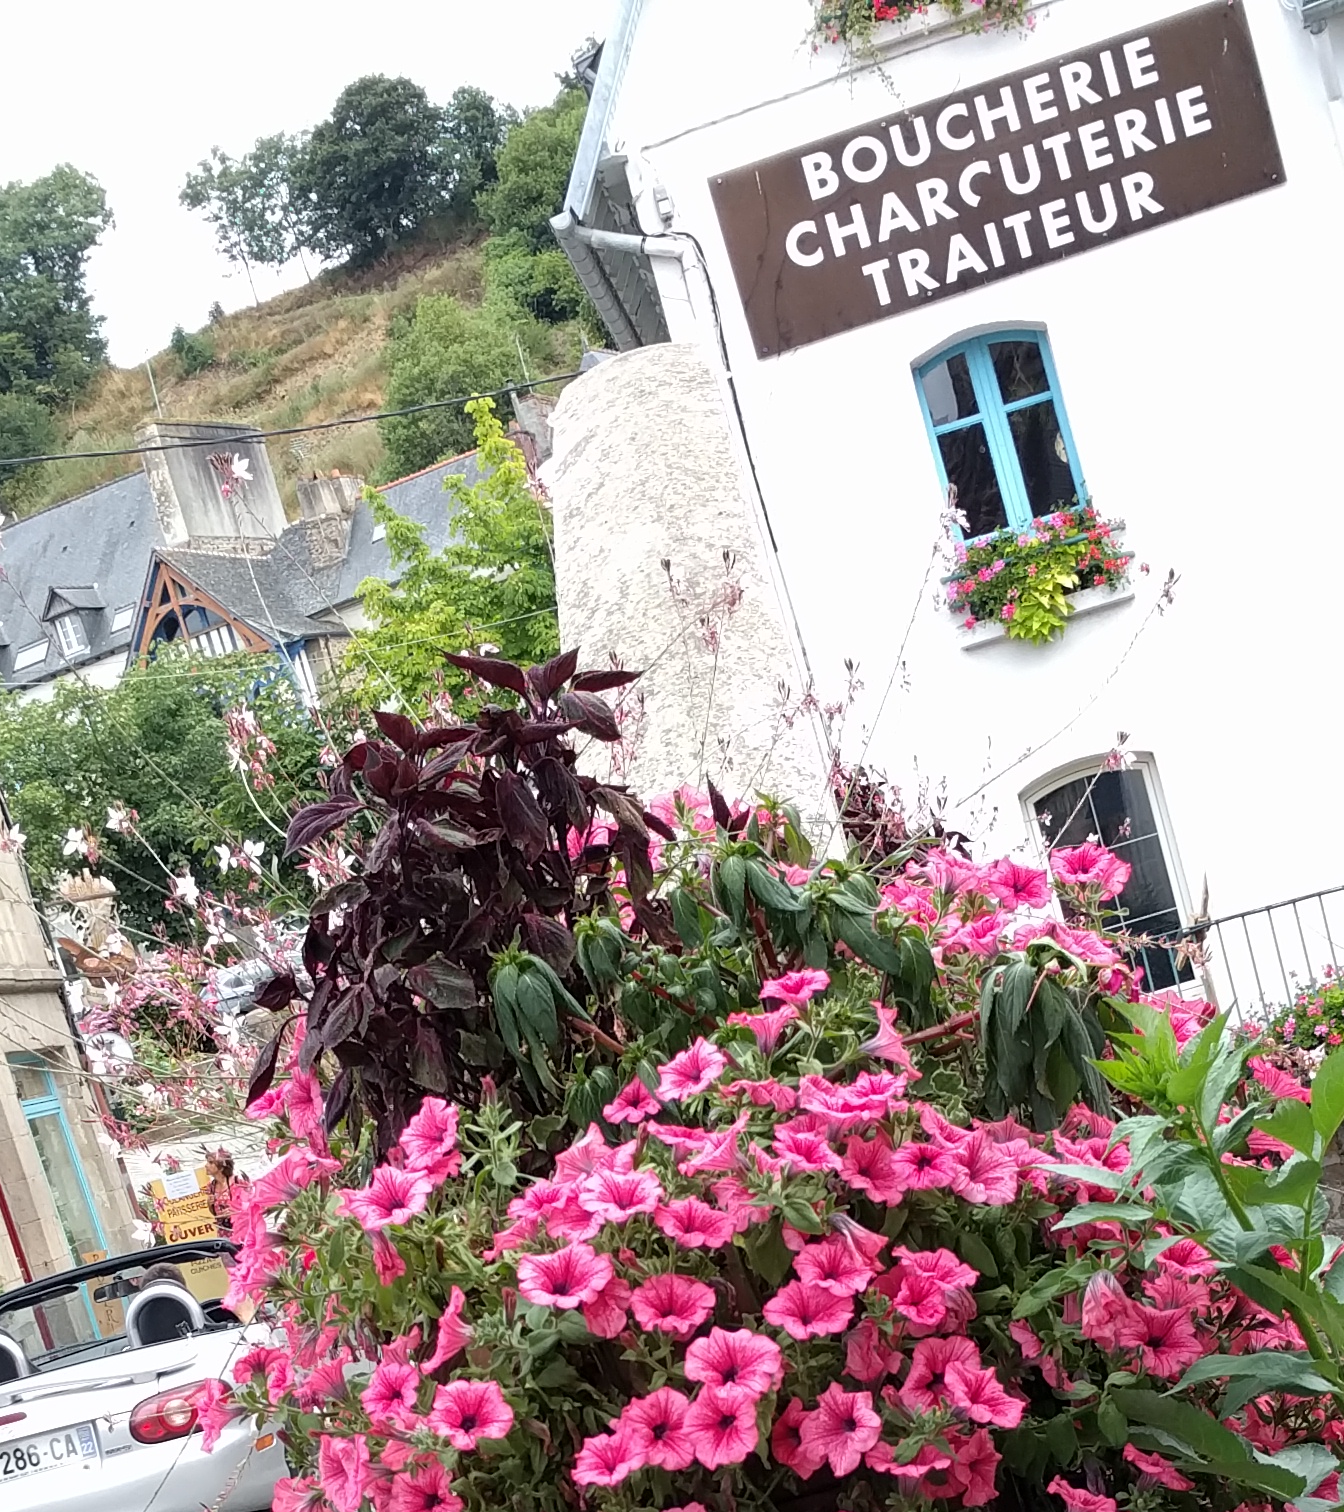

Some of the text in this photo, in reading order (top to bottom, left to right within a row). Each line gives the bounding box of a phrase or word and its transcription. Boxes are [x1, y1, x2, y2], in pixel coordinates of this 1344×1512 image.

[785, 85, 1214, 268] CHARCUTERIE
[801, 37, 1160, 202] BOUCHERIE
[862, 171, 1165, 306] TRAITEUR
[169, 1222, 217, 1243] OUVER
